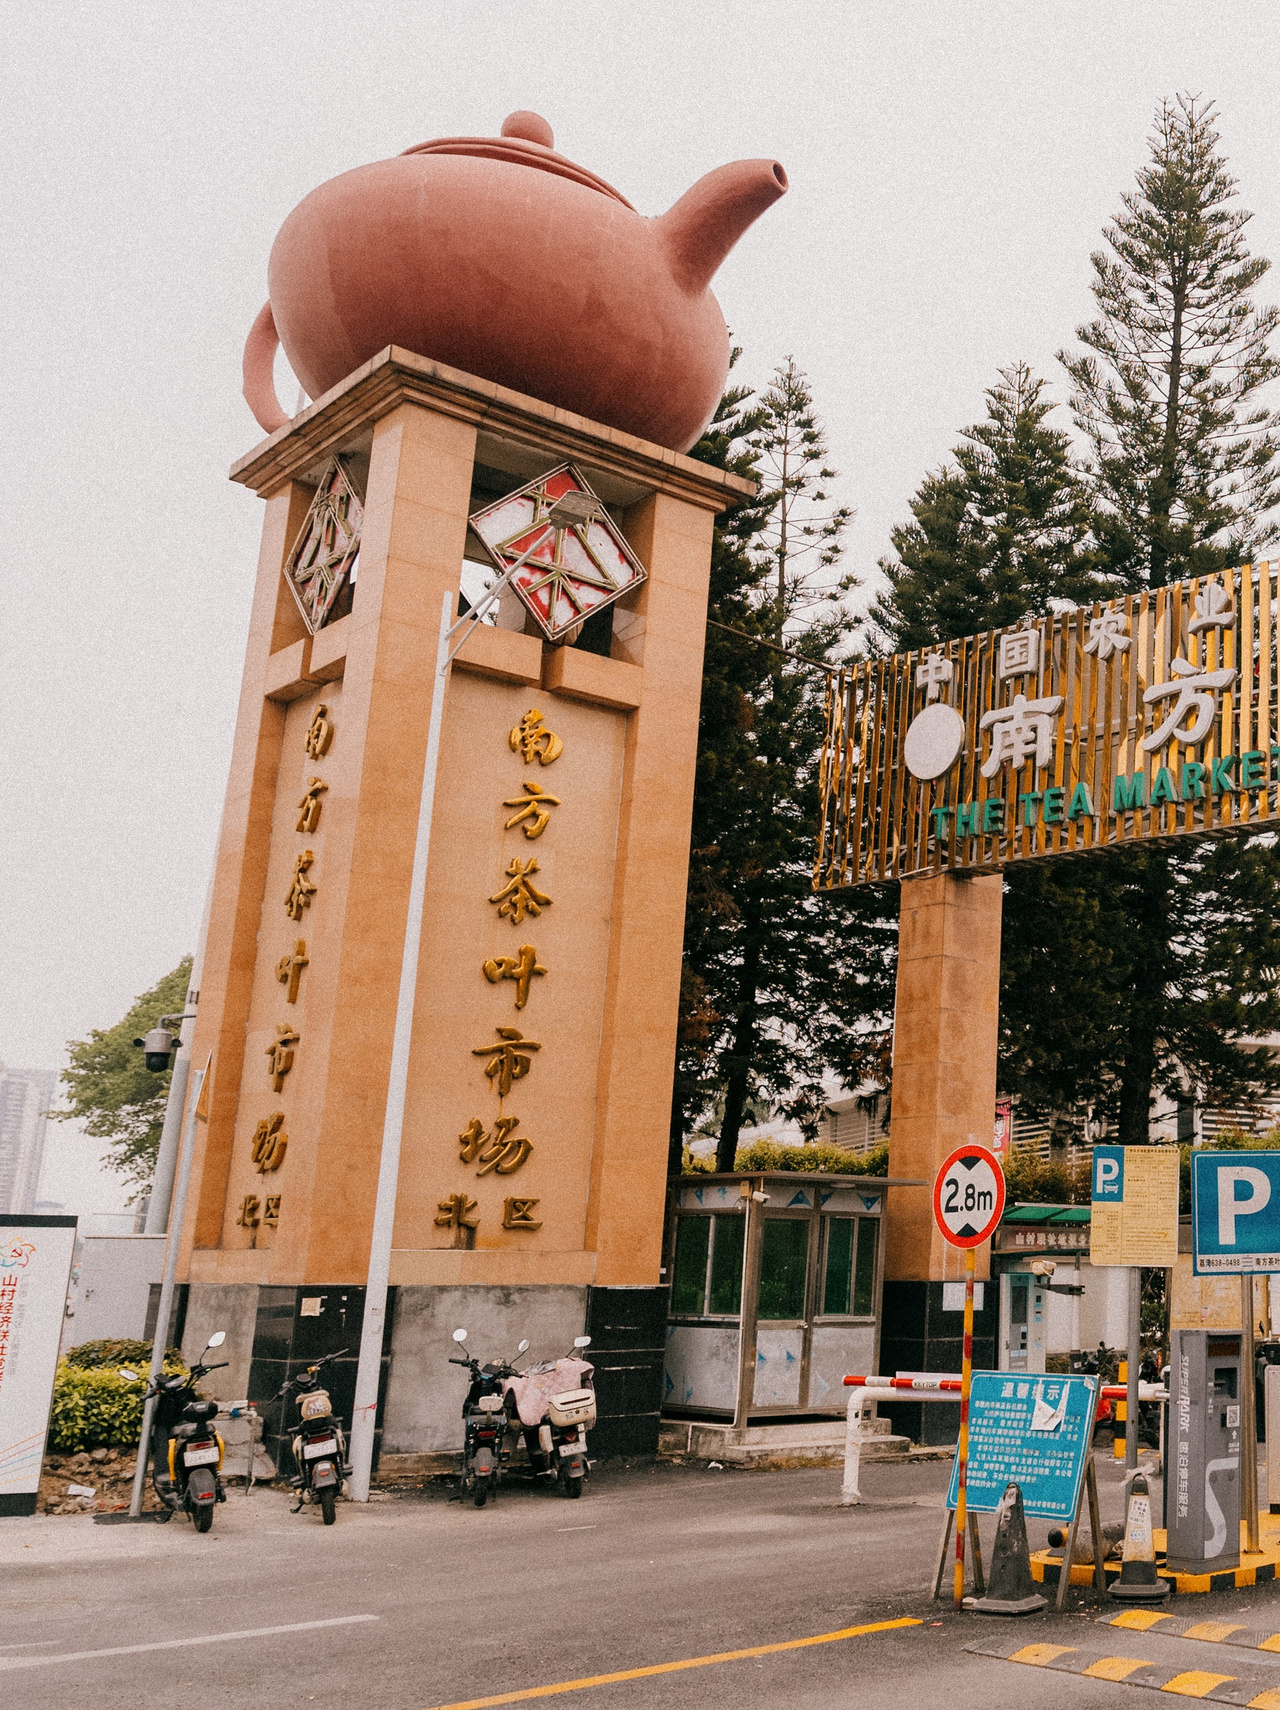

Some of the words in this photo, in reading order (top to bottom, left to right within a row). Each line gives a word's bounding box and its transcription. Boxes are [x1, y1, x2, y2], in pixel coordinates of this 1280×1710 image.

[932, 797, 1006, 841] THE
[1019, 781, 1094, 828] TEA
[251, 703, 335, 1175] 南方茶叶市场
[460, 708, 565, 1178] 南方茶叶市场
[944, 1177, 993, 1214] 2.8m
[1096, 1158, 1120, 1194] P
[236, 1193, 282, 1230] 北区
[434, 1192, 545, 1232] 北区
[1217, 1166, 1271, 1246] P
